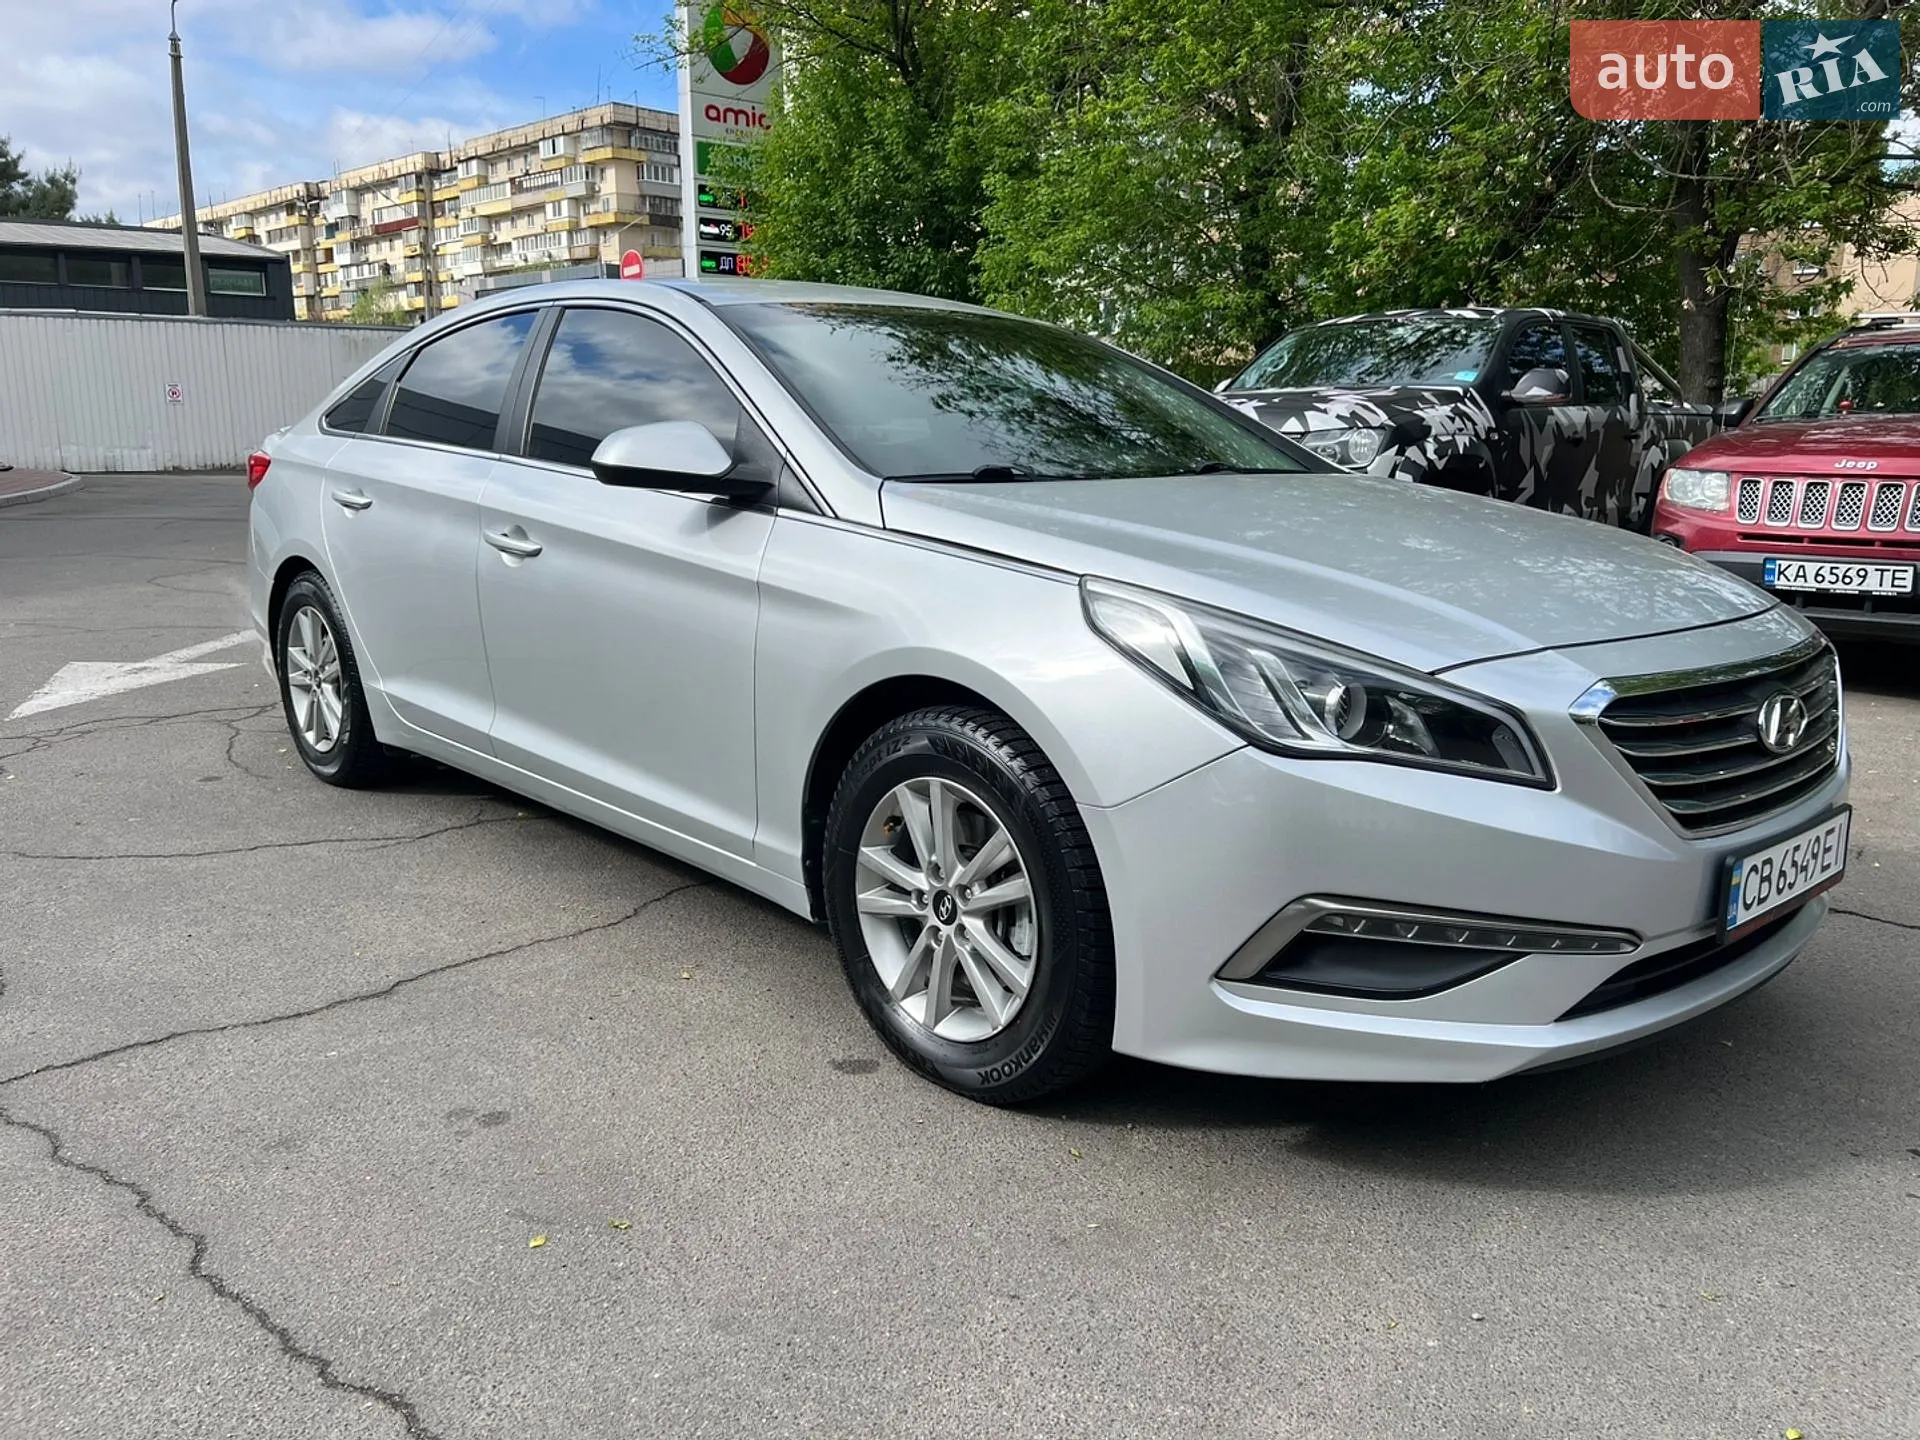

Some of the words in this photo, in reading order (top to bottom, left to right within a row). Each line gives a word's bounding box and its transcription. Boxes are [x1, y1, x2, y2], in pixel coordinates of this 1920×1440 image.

[1834, 459, 1878, 470] Jeep
[1777, 563, 1807, 583] KA
[1814, 566, 1868, 586] 6569
[1874, 568, 1909, 588] TE
[1776, 835, 1821, 896] 6549
